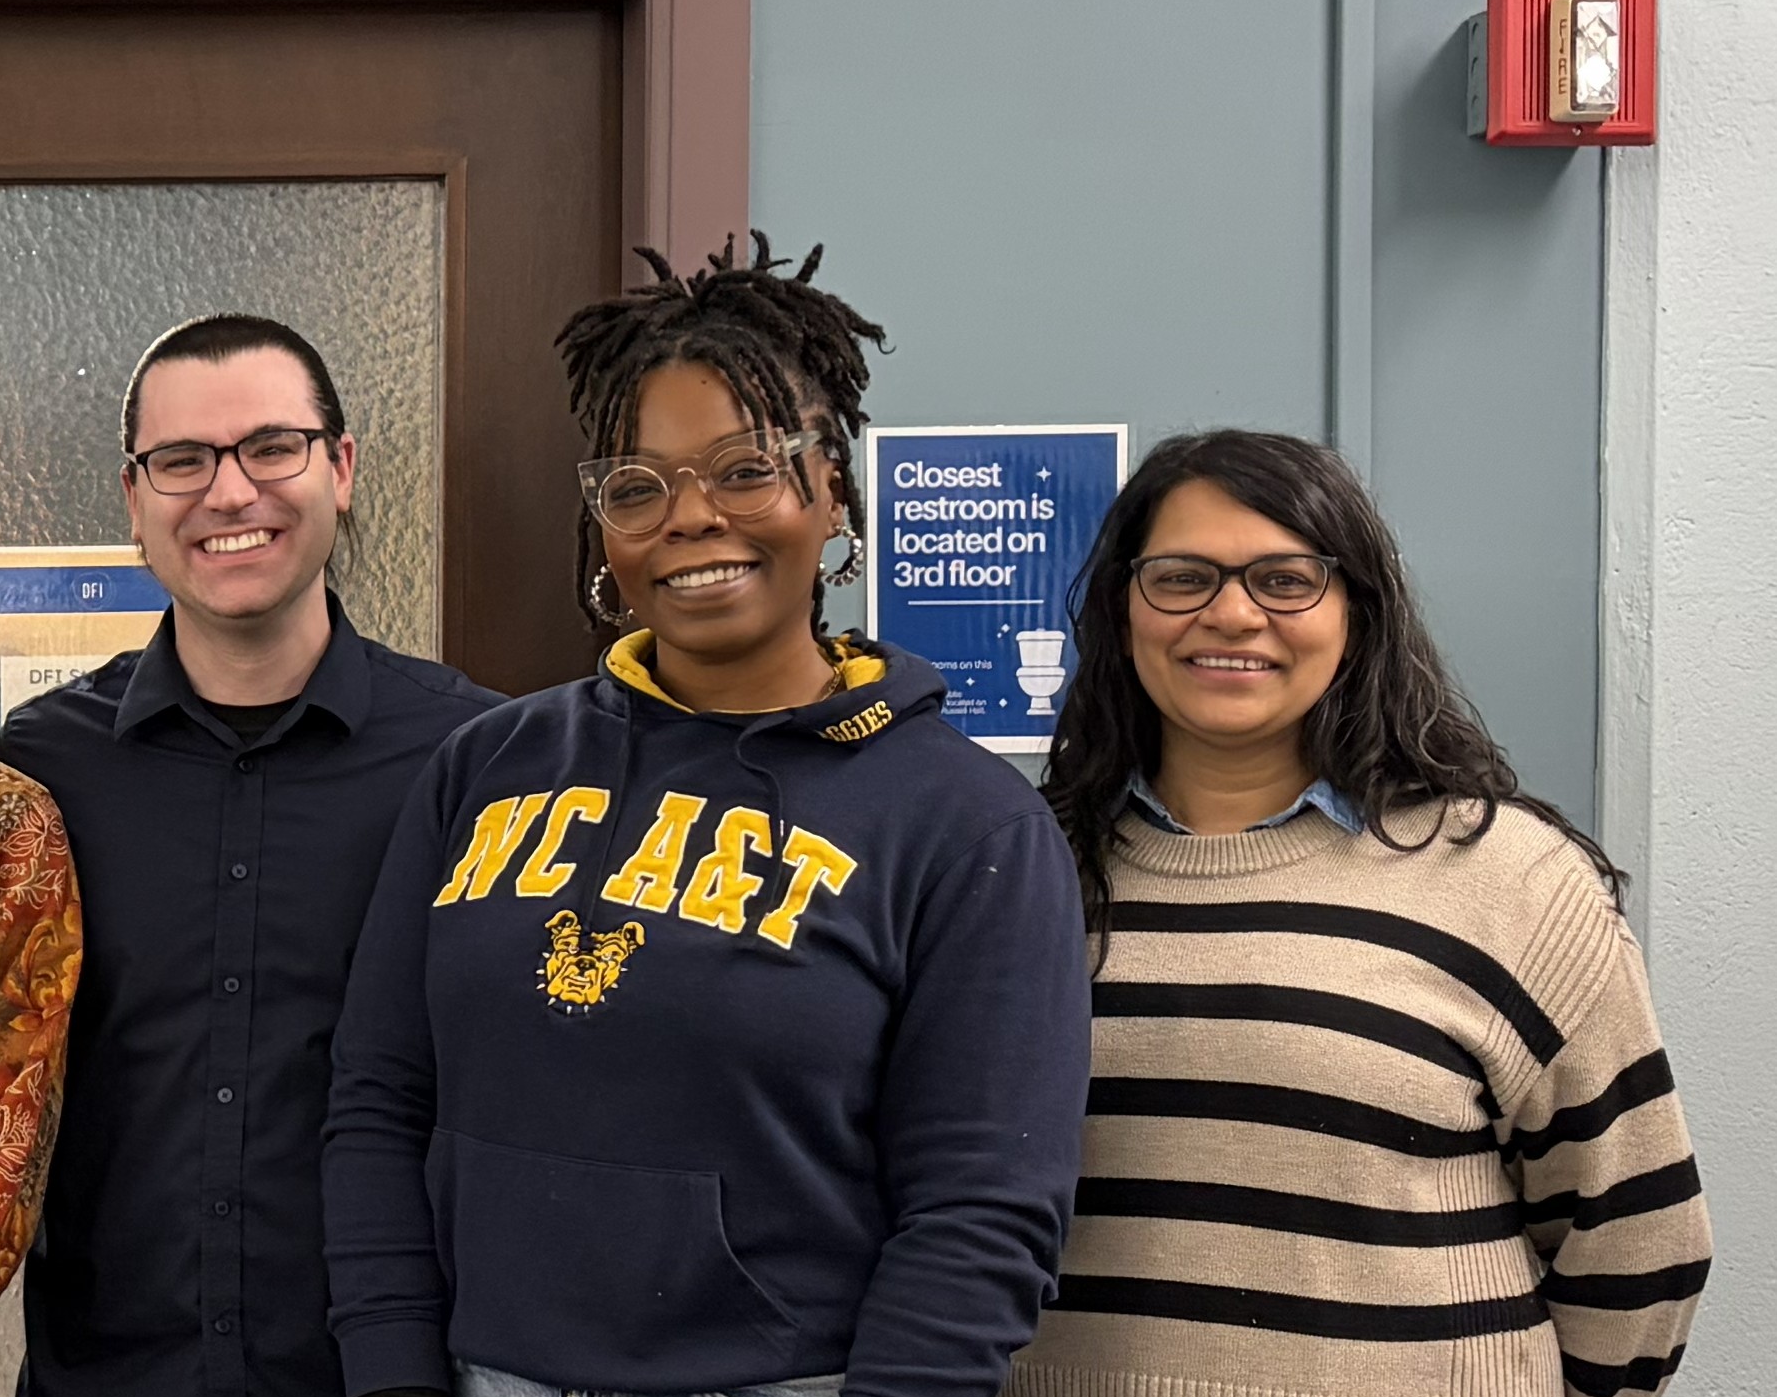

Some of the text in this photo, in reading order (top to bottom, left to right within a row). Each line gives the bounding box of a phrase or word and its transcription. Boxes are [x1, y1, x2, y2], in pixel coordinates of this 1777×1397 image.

[1558, 18, 1568, 95] FIRE
[893, 460, 1003, 489] Closest
[893, 492, 1055, 521] restroom is
[893, 526, 1047, 554] located on
[893, 559, 1017, 587] 3rd floor
[82, 582, 104, 600] DFI
[29, 669, 62, 685] DFI
[959, 661, 973, 670] on
[974, 660, 993, 670] this
[432, 786, 859, 951] NC A&T
